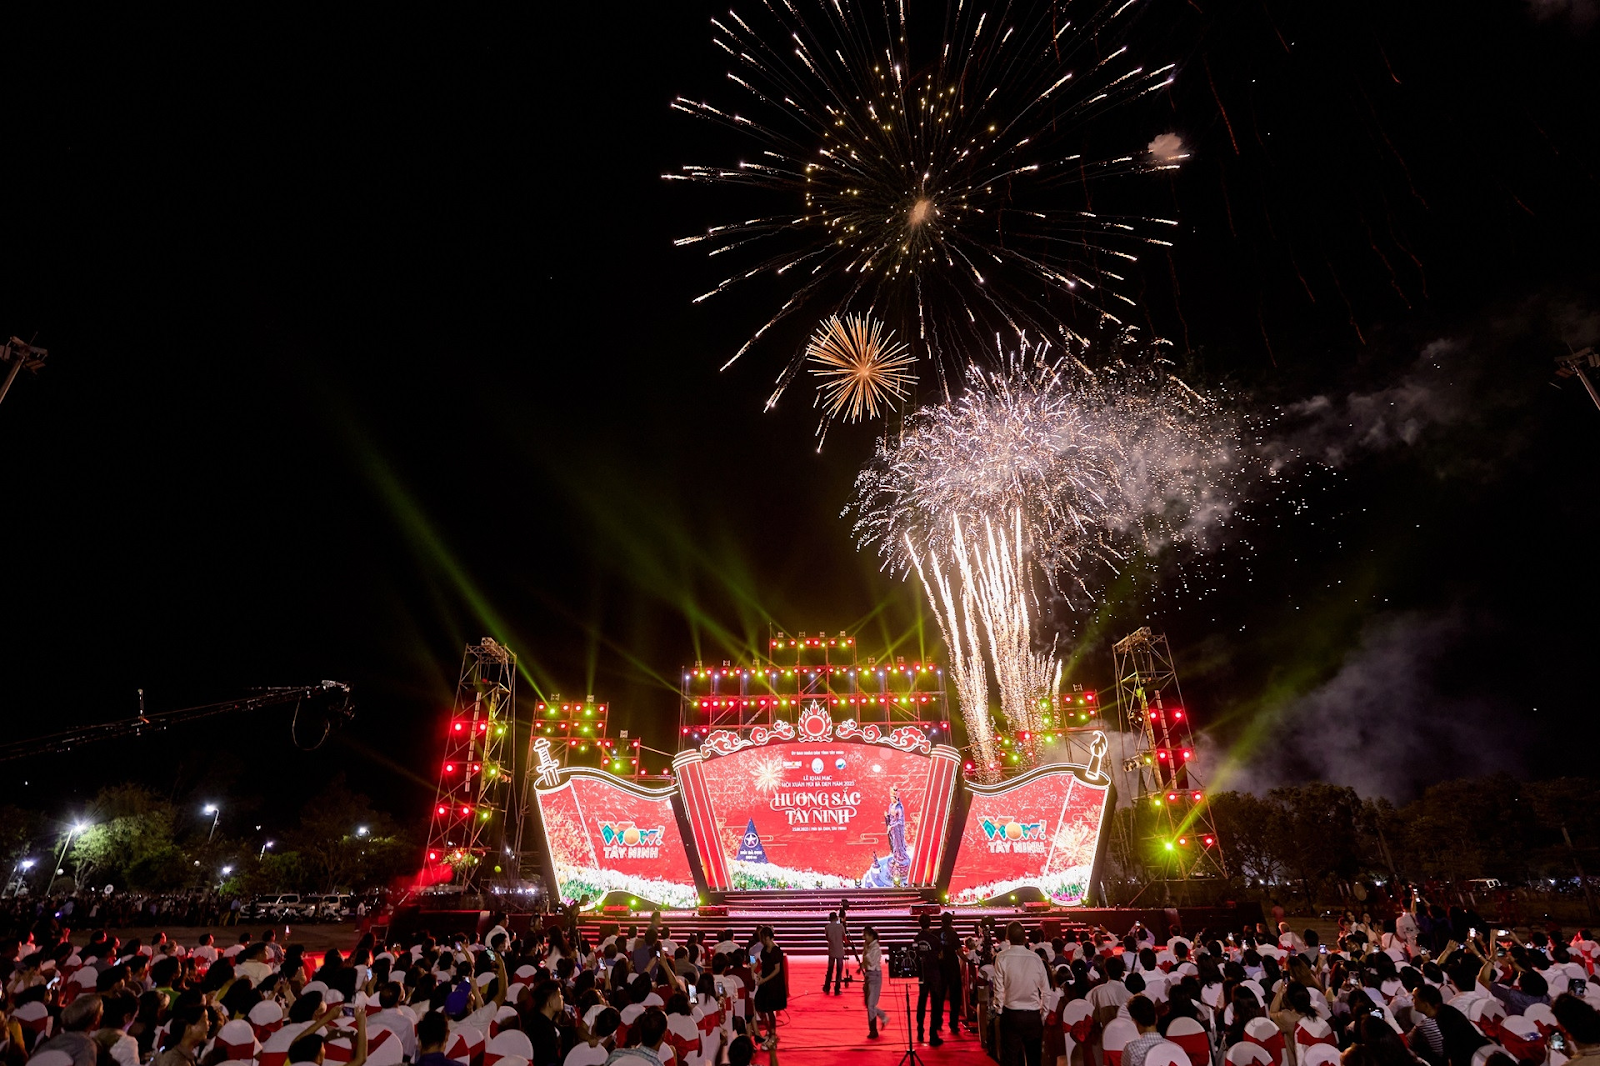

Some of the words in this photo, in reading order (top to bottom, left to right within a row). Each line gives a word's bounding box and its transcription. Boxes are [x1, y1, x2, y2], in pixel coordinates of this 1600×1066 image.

[770, 790, 829, 810] HƯƠNG
[831, 786, 861, 806] SẮC
[785, 807, 811, 825] TÂY
[812, 809, 854, 825] NINH
[603, 845, 627, 859] TÂY
[628, 846, 659, 859] NINH
[988, 840, 1011, 853] TÂY
[1012, 841, 1045, 853] NINH
